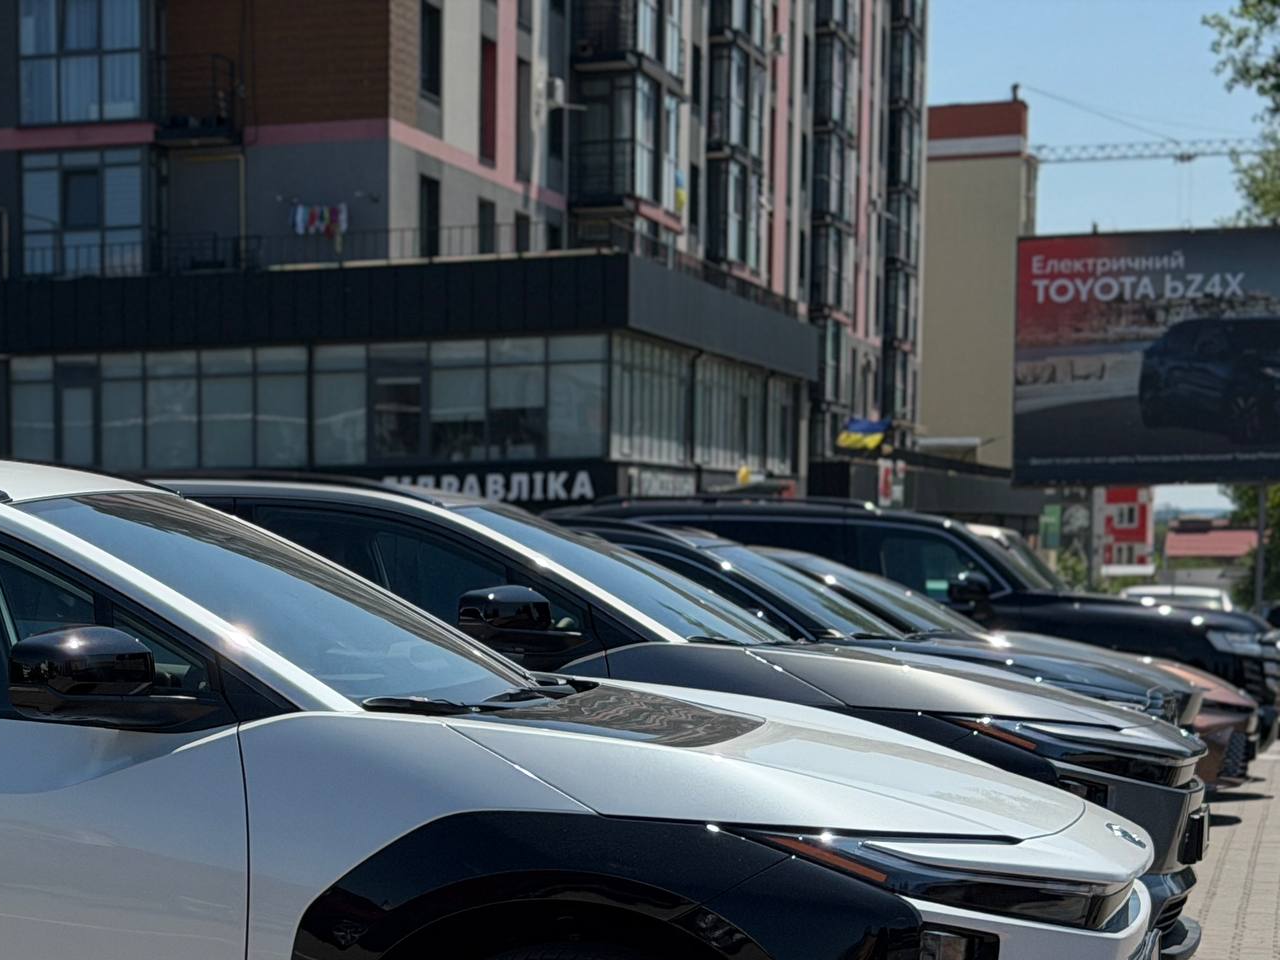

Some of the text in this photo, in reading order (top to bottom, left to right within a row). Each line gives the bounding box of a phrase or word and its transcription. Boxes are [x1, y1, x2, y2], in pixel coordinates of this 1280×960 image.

[1031, 250, 1185, 275] Електричний
[1032, 273, 1245, 303] TOYOTA bZ4X
